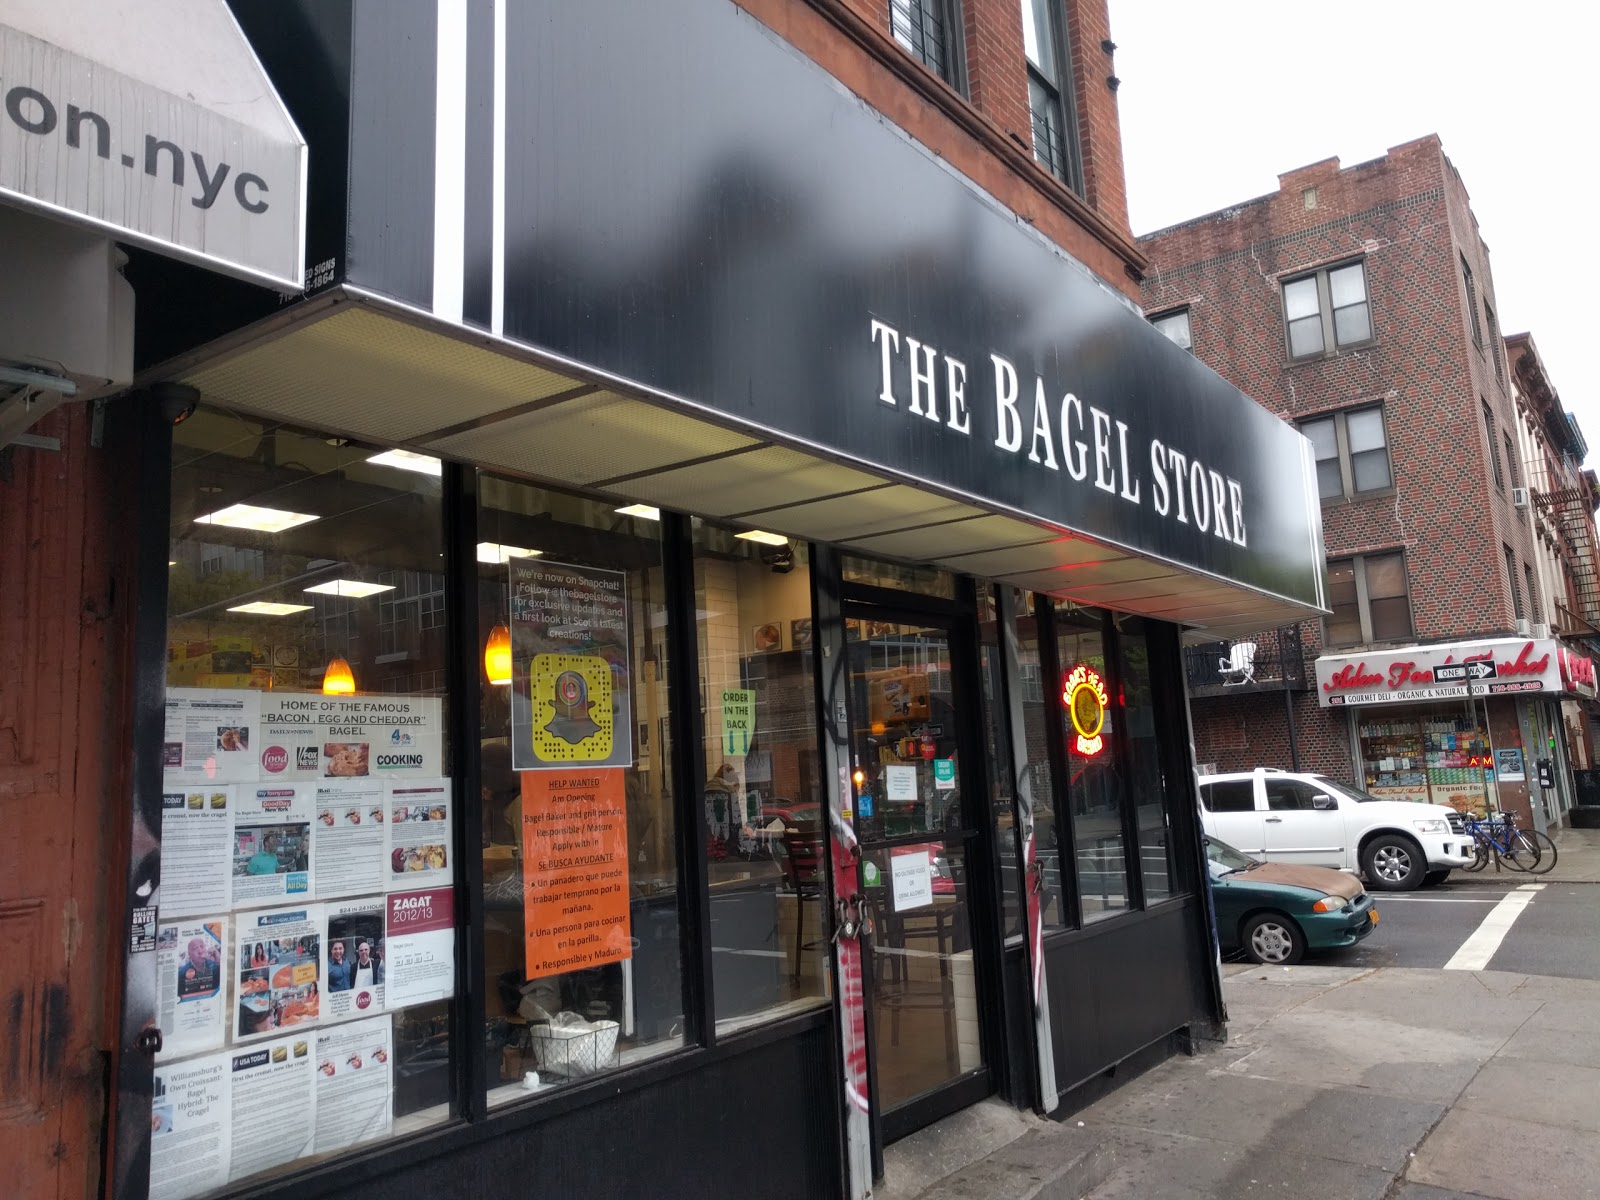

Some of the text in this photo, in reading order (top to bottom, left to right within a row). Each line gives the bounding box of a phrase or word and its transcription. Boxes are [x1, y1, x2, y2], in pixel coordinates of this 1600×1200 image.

[5, 86, 269, 214] on.nyc
[314, 258, 336, 276] SIGNS
[871, 319, 1246, 548] THE BAGEL STORE
[517, 568, 543, 580] We're
[545, 574, 564, 583] now
[578, 576, 619, 590] Snapchat!
[520, 582, 550, 594] Follow
[514, 596, 622, 616] for exclusive updates and
[522, 612, 539, 622] first
[542, 614, 560, 624] look
[573, 618, 598, 628] Scot's
[600, 620, 624, 630] latest
[550, 630, 592, 640] creations!
[1323, 662, 1384, 692] Aden
[1442, 669, 1460, 677] ONE
[723, 692, 748, 702] ORDER
[1348, 694, 1376, 702] GOURMET
[1398, 690, 1426, 699] ORGANIC
[1435, 688, 1464, 697] NATURAL
[1467, 686, 1484, 694] OOD
[280, 701, 410, 712] HOME OF THE FAMOUS
[724, 706, 748, 715] IN THE
[318, 715, 340, 724] EGG
[344, 715, 366, 724] AND
[727, 720, 747, 728] BACK
[330, 727, 366, 736] BAGEL
[392, 729, 400, 740] 4
[264, 752, 288, 766] food
[377, 754, 423, 766] COOKING
[1470, 757, 1492, 766] AM
[549, 778, 600, 788] HELP WANTED
[566, 794, 596, 803] Opening
[524, 814, 544, 824] Bagel
[546, 812, 566, 821] Baker
[569, 810, 581, 818] and
[584, 808, 596, 819] grill
[536, 824, 580, 837] Responsible
[587, 824, 612, 832] Mature
[552, 841, 572, 851] Apply
[575, 840, 590, 848] with
[538, 853, 614, 870] SE BUSCA AYUDANTE
[538, 868, 622, 888] Un panadero que puede
[533, 892, 562, 904] trabajar
[564, 888, 598, 900] temprano
[600, 886, 612, 896] por
[394, 896, 432, 910] ZAGAT
[562, 904, 594, 914] mañana.
[394, 908, 432, 922] 2012/13
[536, 914, 626, 937] Una persona para cocinar
[558, 934, 602, 948] en la parilla.
[542, 947, 622, 970] Responsible y Maduro
[240, 1053, 267, 1066] USA TODAY
[170, 1064, 223, 1082] Williamsburg's
[170, 1074, 223, 1092] Own Croissant-
[188, 1088, 206, 1098] Bagel
[206, 1095, 219, 1103] The
[187, 1106, 210, 1118] Cragel
